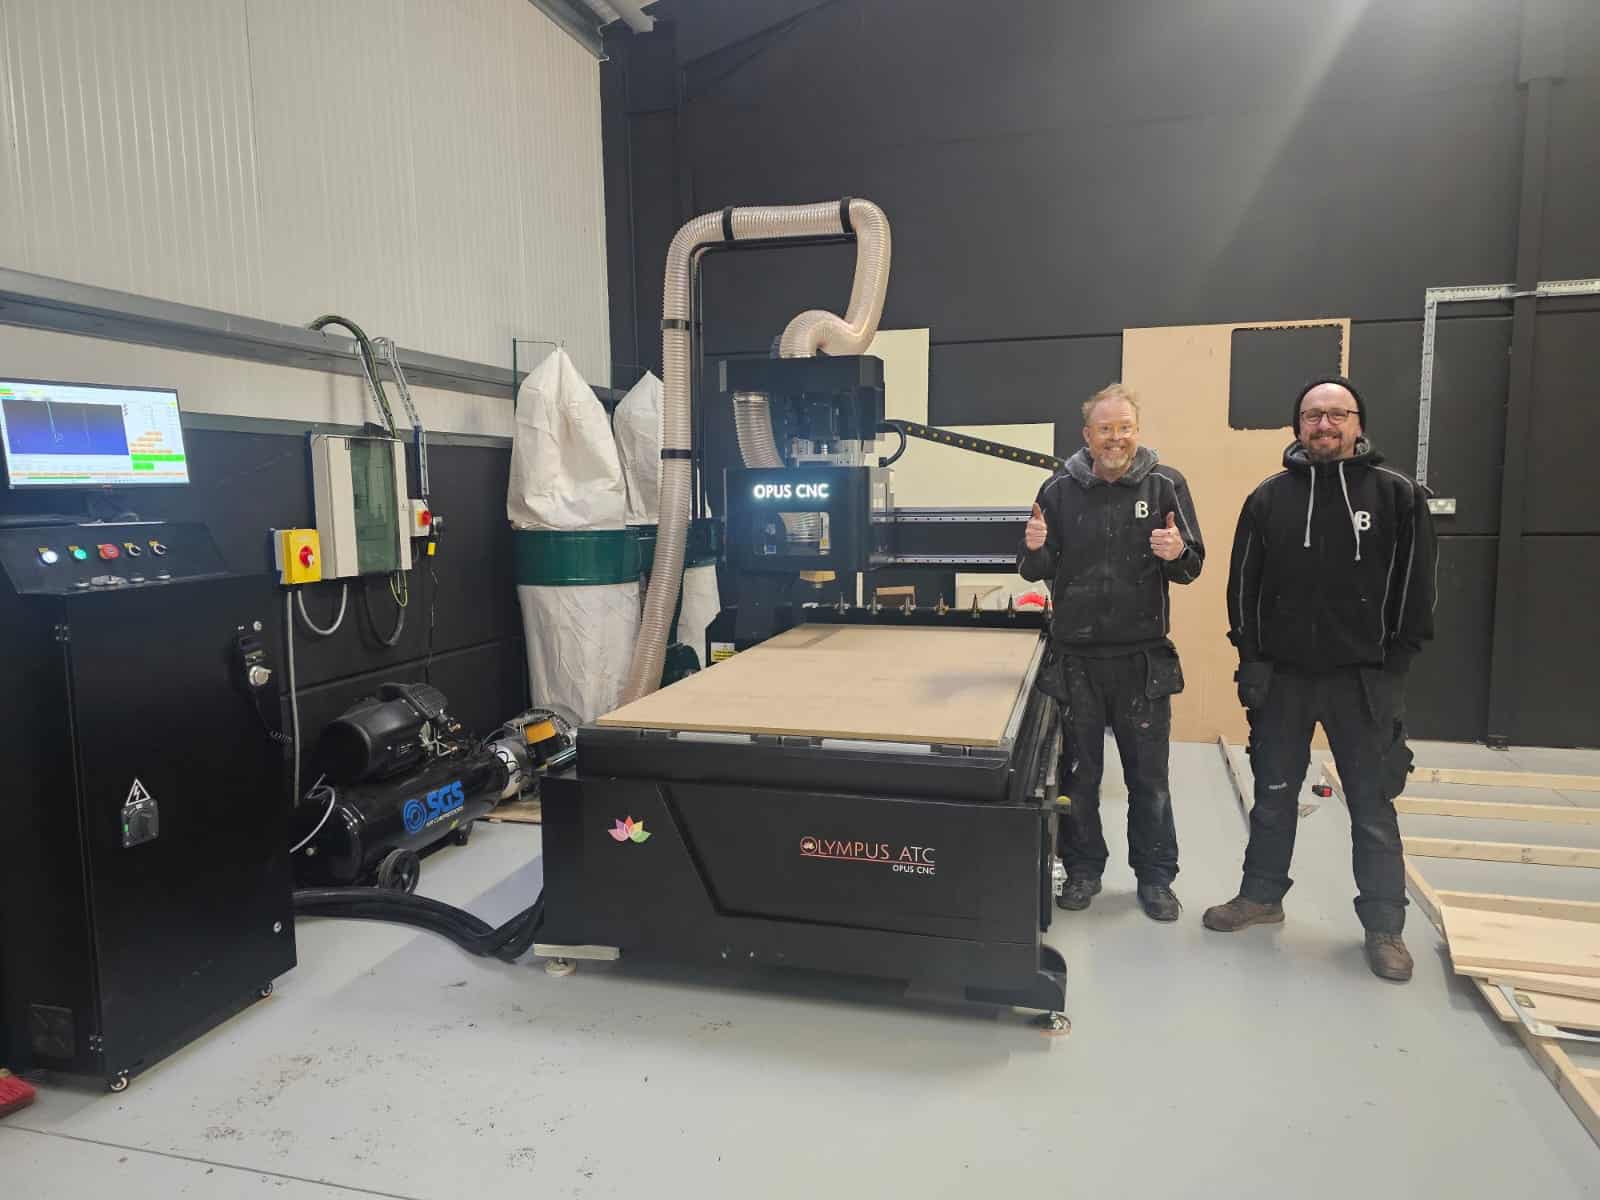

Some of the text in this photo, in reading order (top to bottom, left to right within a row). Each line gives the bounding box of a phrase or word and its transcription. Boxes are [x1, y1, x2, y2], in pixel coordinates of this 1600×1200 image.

[753, 483, 830, 499] OPUS CNC
[1135, 500, 1149, 519] B
[427, 780, 465, 820] SGS
[800, 836, 936, 863] OLYMPUS ATC
[892, 863, 936, 875] OPUS CNC
